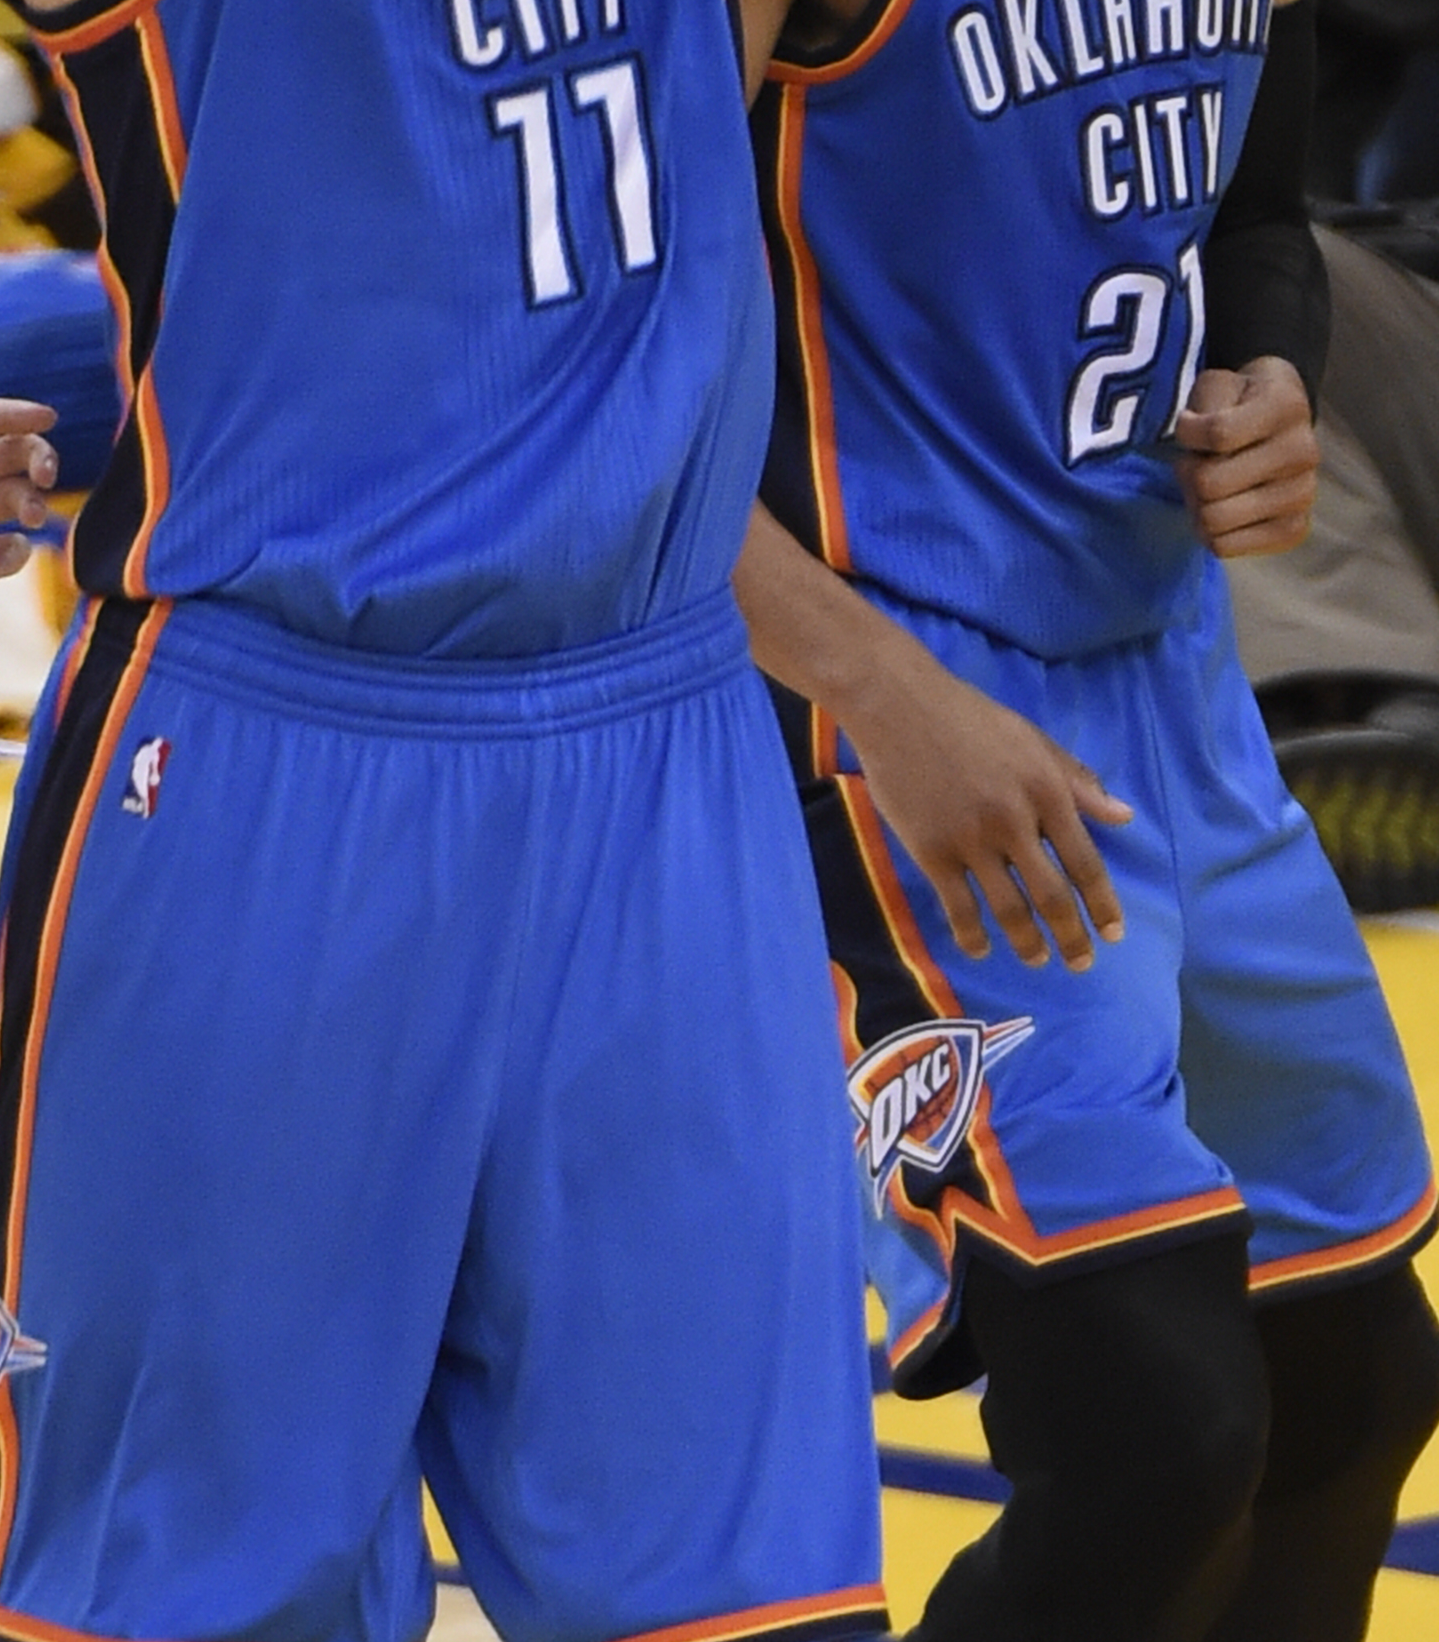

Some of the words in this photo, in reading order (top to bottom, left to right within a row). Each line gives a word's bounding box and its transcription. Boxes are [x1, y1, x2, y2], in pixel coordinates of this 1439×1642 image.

[492, 59, 662, 307] 11
[1085, 88, 1224, 218] CITY
[1065, 241, 1207, 464] 21
[870, 1042, 952, 1170] OKC
